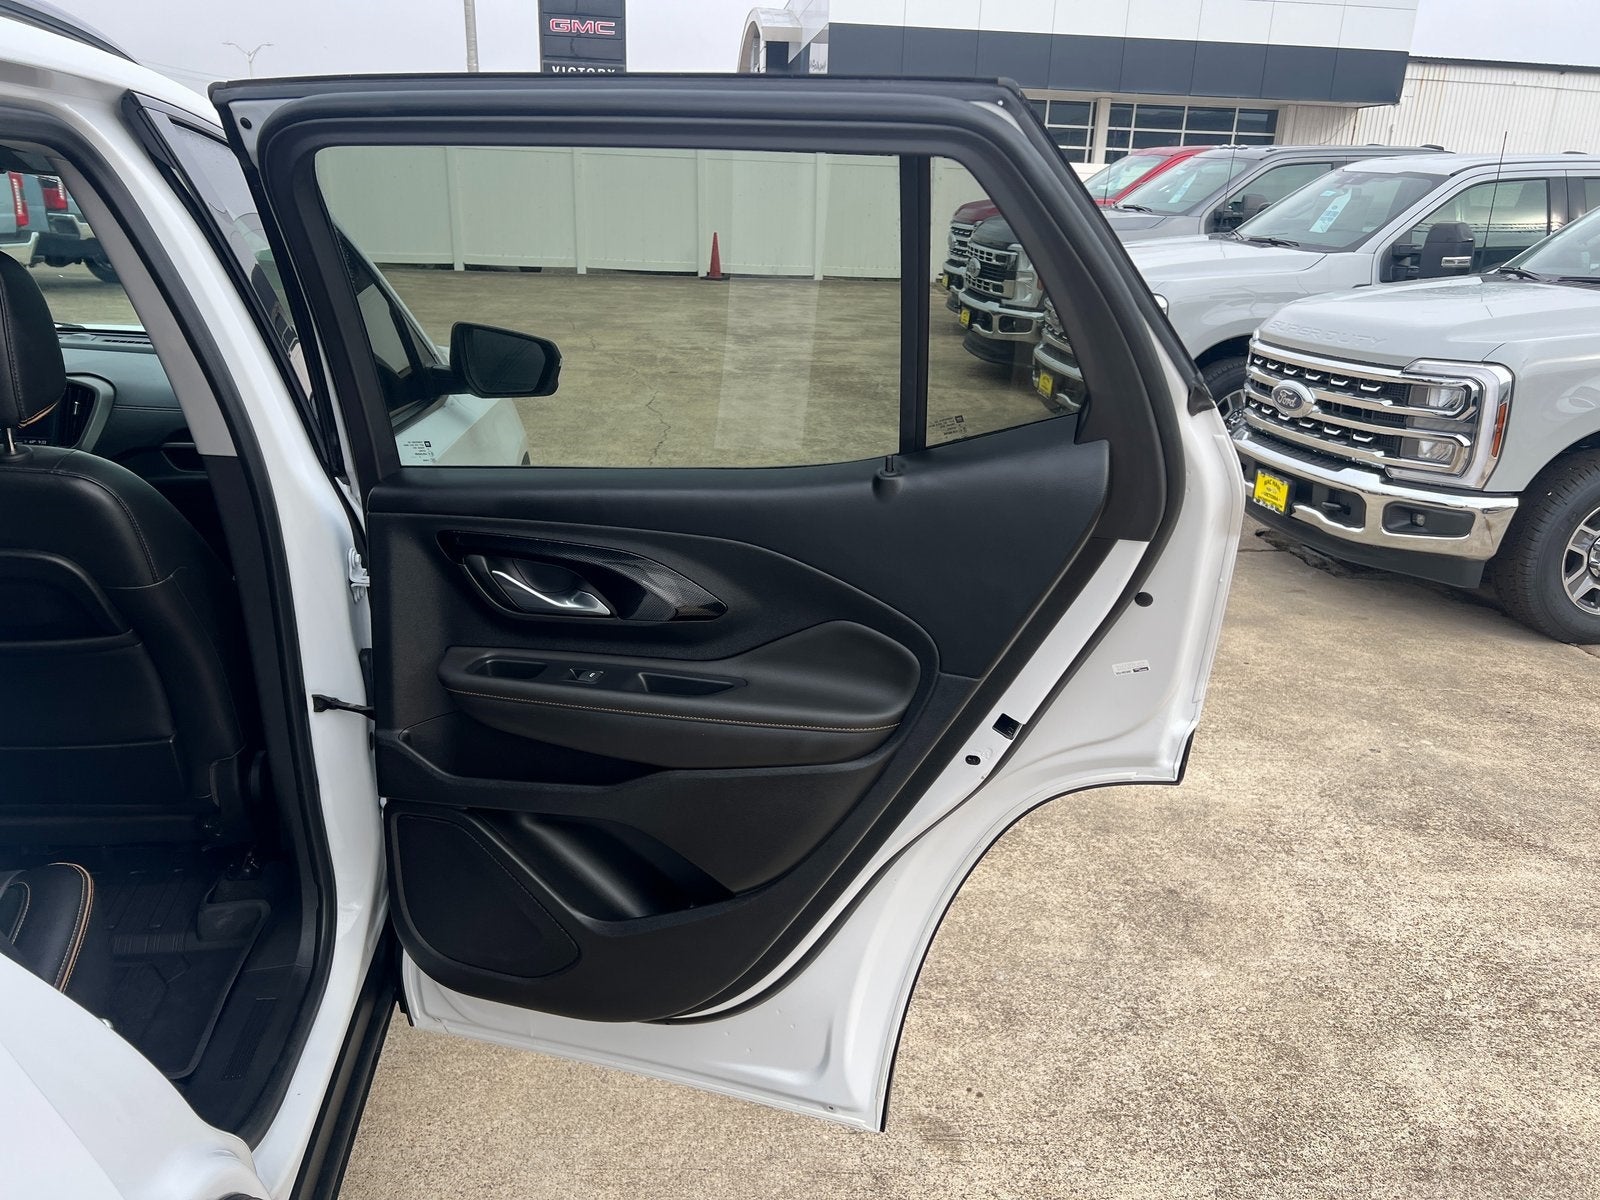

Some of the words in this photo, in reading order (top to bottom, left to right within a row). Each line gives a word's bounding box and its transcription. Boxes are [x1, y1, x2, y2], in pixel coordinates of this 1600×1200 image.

[550, 18, 615, 35] GMC
[1269, 320, 1321, 338] SUPER
[1323, 330, 1388, 346] DUTY
[1277, 389, 1297, 407] Ford
